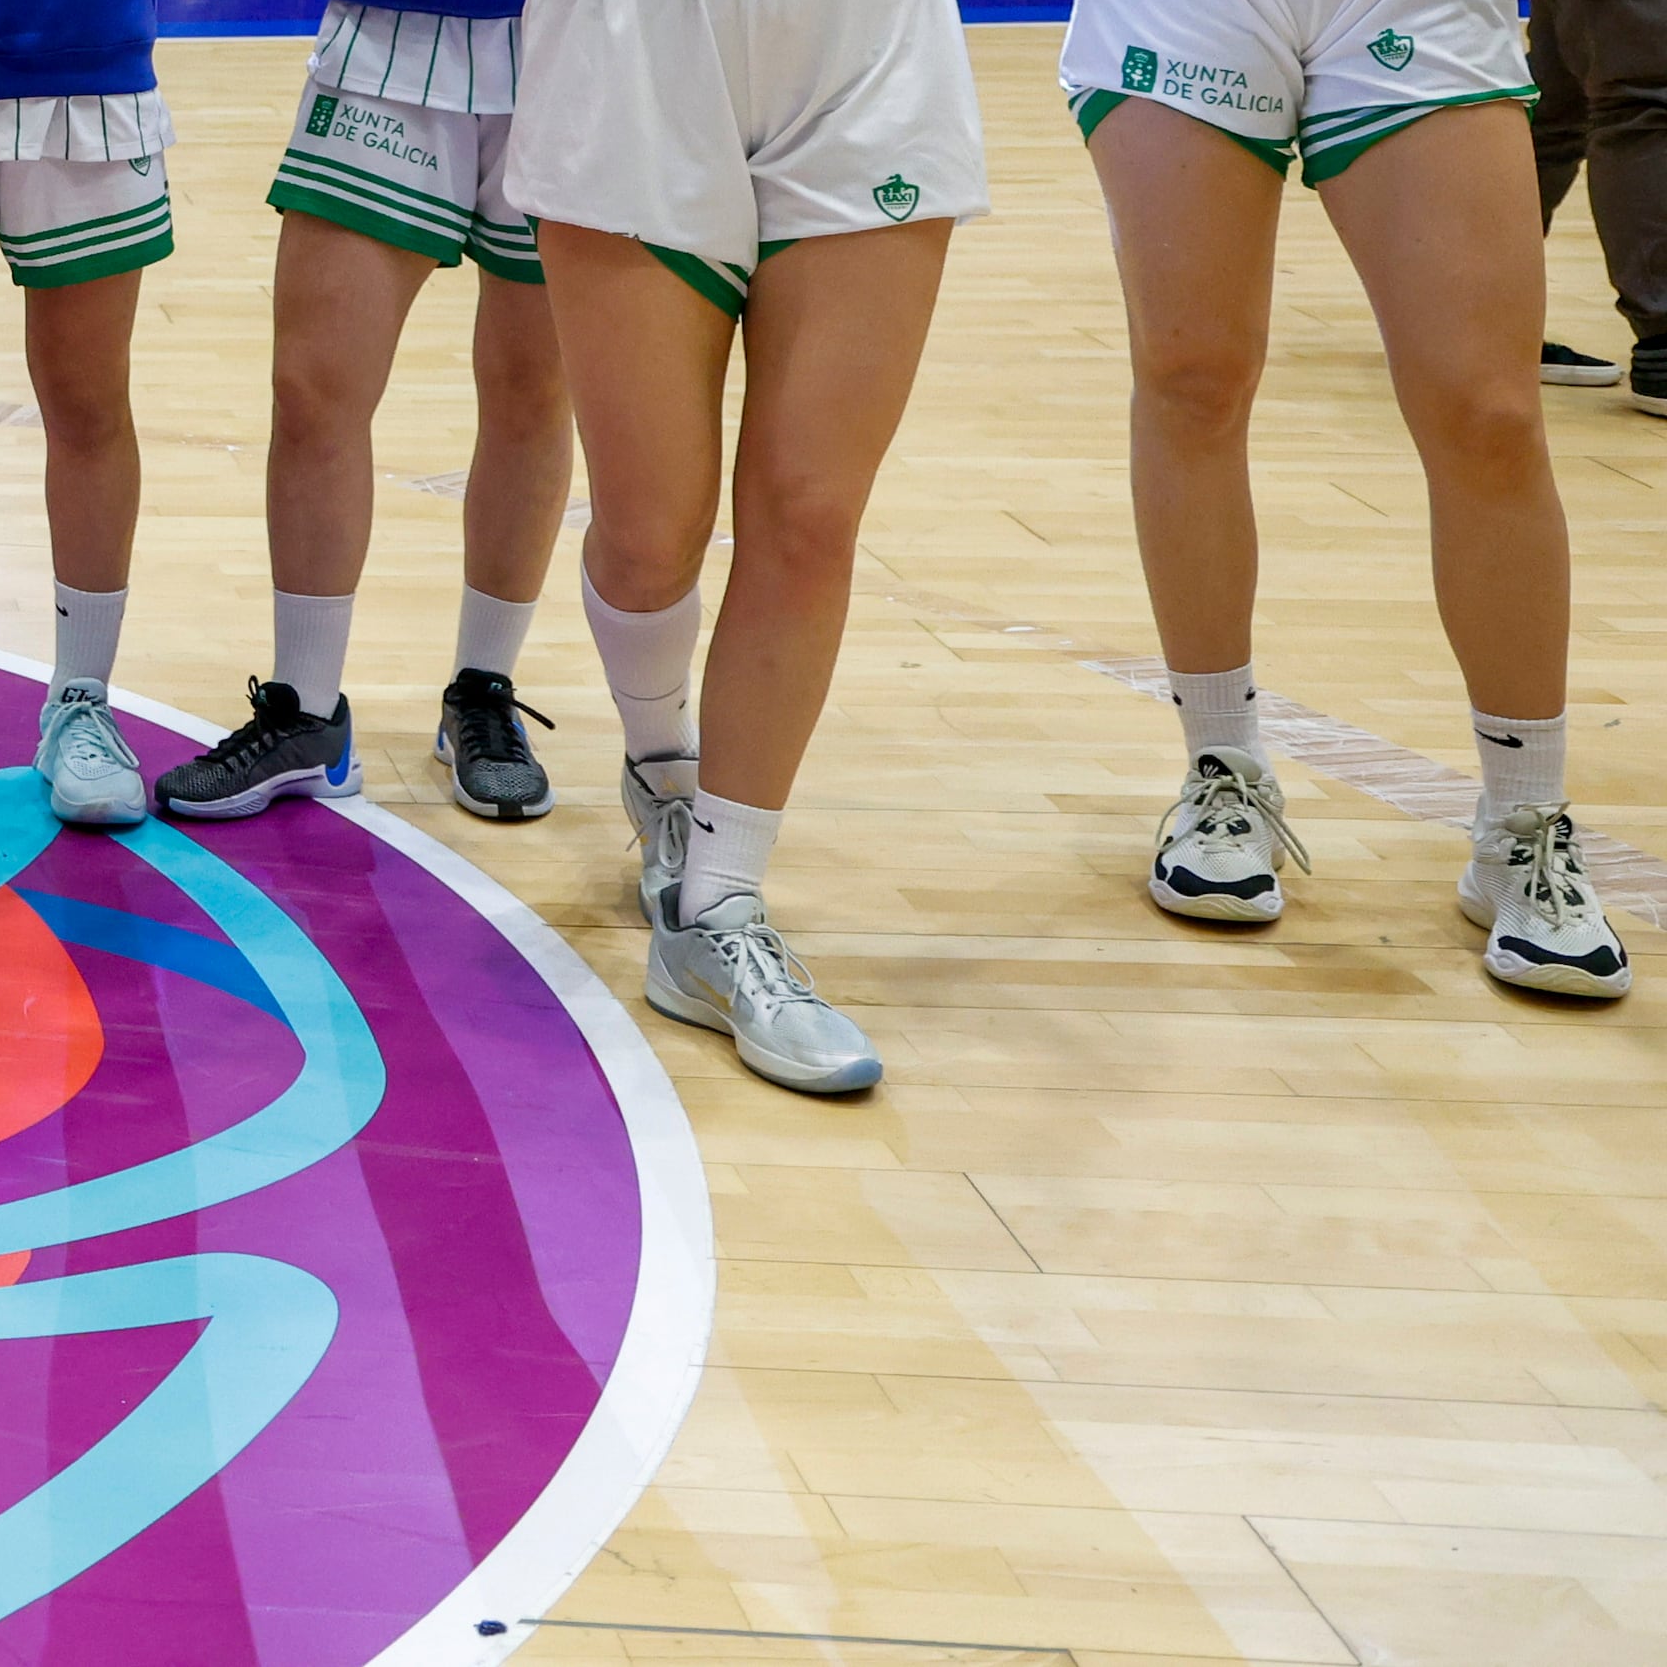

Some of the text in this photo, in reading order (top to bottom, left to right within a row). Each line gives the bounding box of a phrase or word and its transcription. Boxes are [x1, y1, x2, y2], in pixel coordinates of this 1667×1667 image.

[1166, 59, 1249, 90] XUNTA
[1162, 79, 1284, 114] DE GALICIA
[340, 102, 405, 138] XUNTA
[333, 122, 439, 171] DE GALICIA
[881, 193, 913, 203] BAXI
